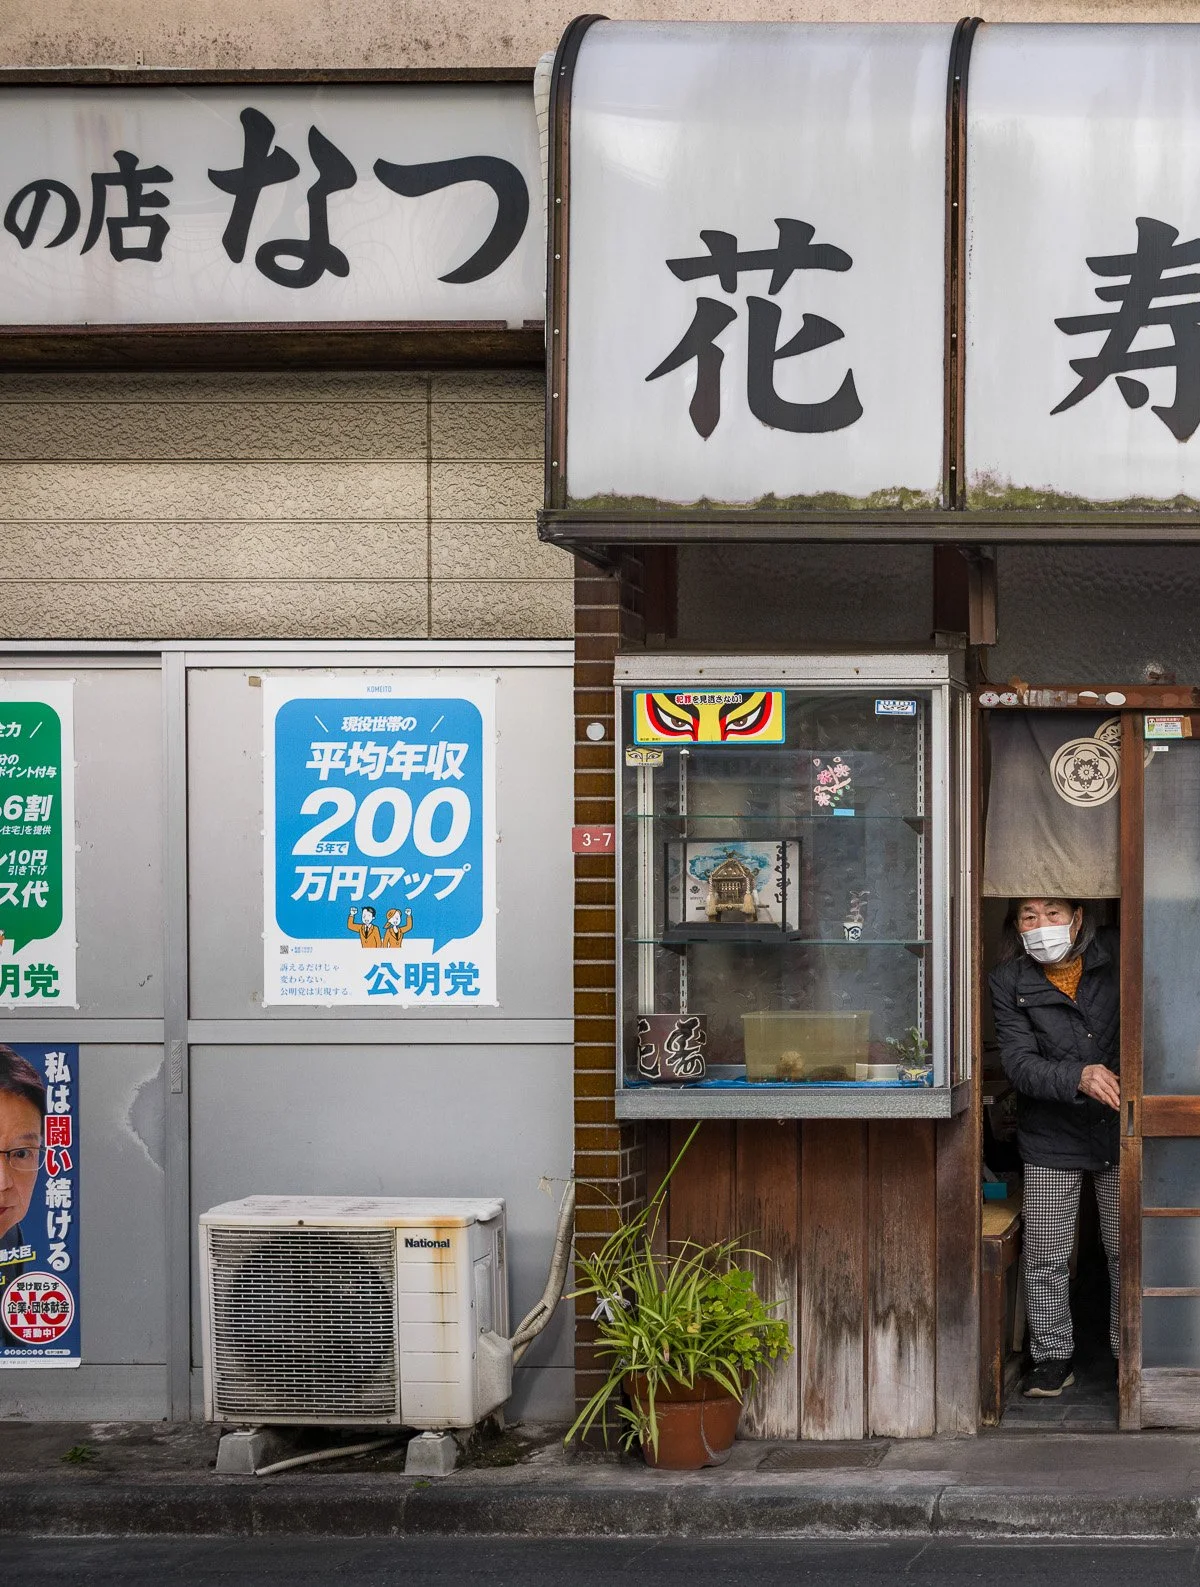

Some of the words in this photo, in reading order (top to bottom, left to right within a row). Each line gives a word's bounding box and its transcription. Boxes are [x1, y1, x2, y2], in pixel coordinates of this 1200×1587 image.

[3, 150, 174, 262] の店
[208, 107, 530, 289] なつ
[366, 685, 392, 693] KOMEITO
[340, 715, 417, 733] 現役世帯の
[305, 740, 470, 781] 平均年収
[0, 794, 54, 822] 6割
[291, 786, 472, 858] 200
[315, 842, 347, 854] 5年で
[582, 832, 612, 847] 3-7
[8, 849, 48, 866] 10円
[8, 865, 48, 876] 引き下げ
[290, 863, 472, 902] 万円アップ
[364, 961, 481, 997] 公明党
[44, 1051, 73, 1272] 私は闘い続ける
[404, 1238, 450, 1248] National
[16, 1282, 60, 1292] 受け取らず
[7, 1300, 70, 1314] 企業・団体献金
[22, 1327, 56, 1338] 活動中!
